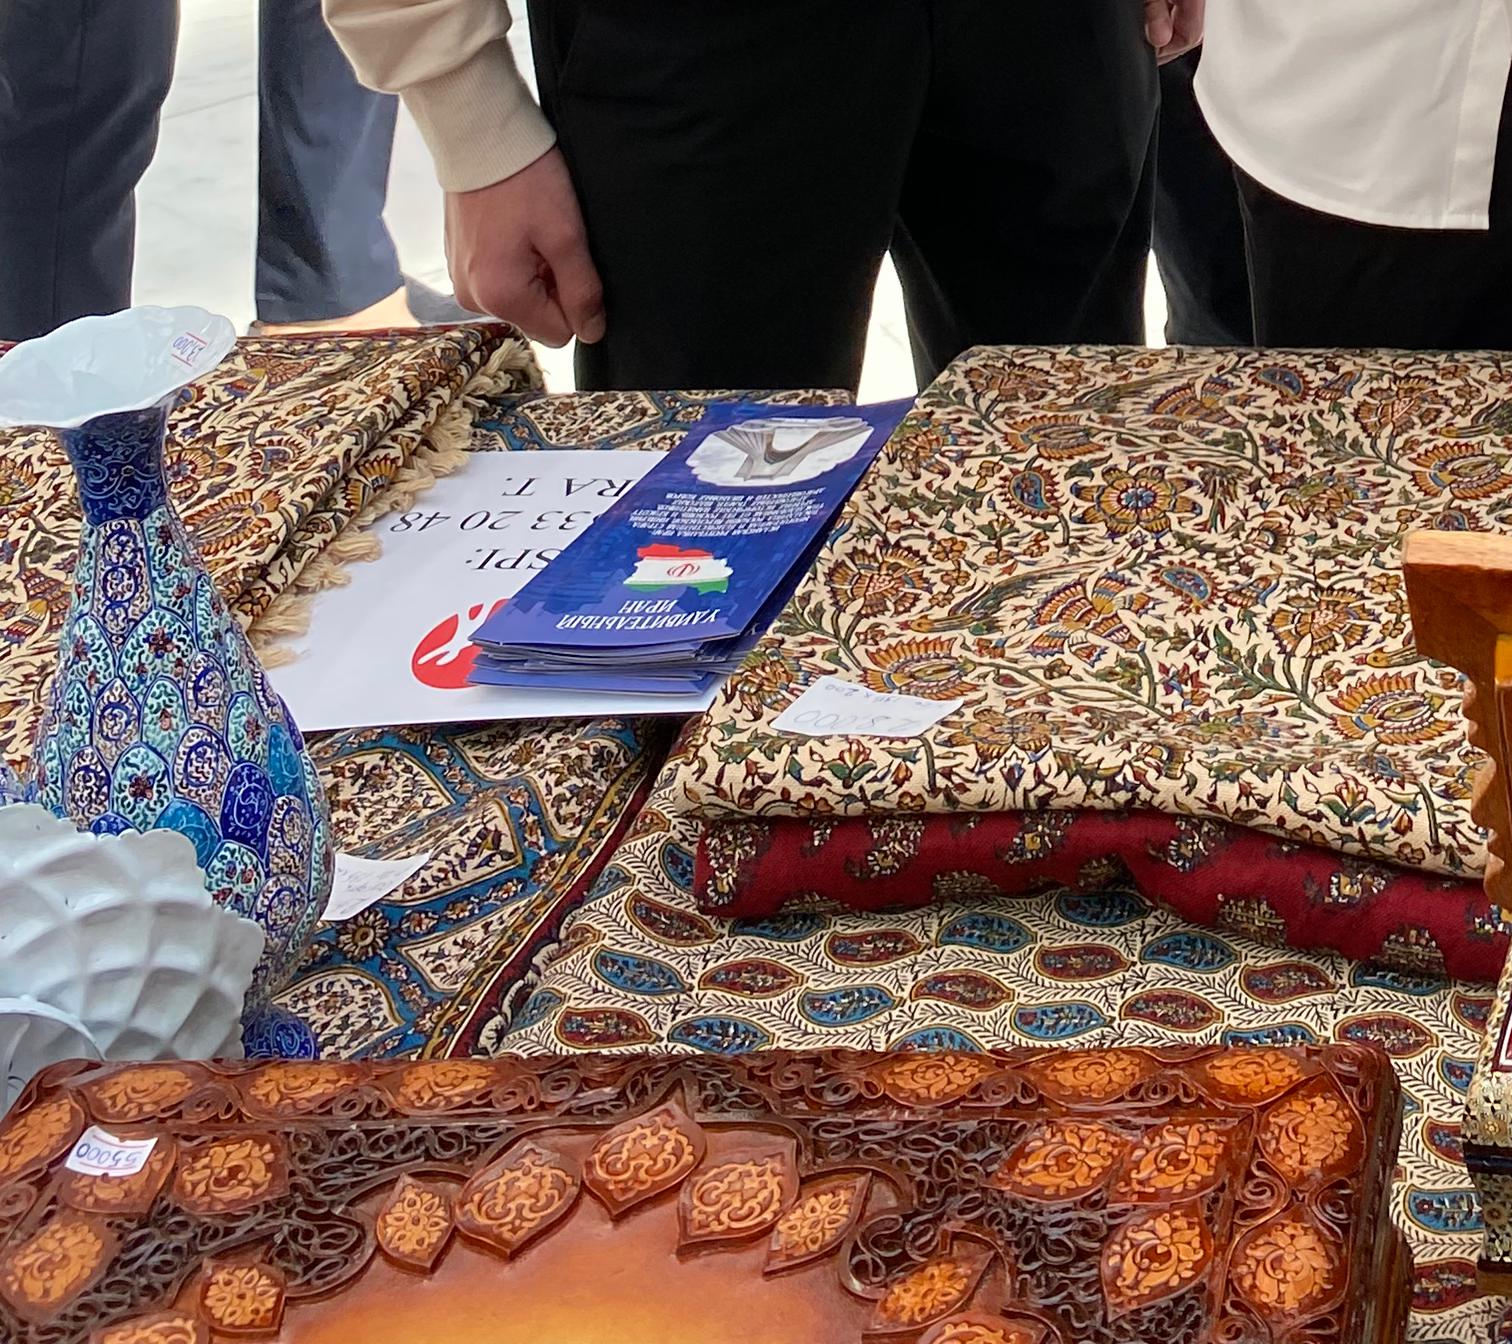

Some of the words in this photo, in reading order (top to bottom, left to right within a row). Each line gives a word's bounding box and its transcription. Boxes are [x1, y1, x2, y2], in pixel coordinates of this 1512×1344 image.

[501, 477, 541, 498] T.
[564, 477, 637, 498] RA
[388, 512, 452, 533] 48
[459, 510, 524, 532] 20
[530, 511, 600, 531] 33
[465, 548, 563, 570] SPI:
[617, 598, 678, 615] ИРАН
[555, 603, 721, 633] УДИВИТЕЛЬНЫЙ
[76, 1143, 142, 1168] 55000
